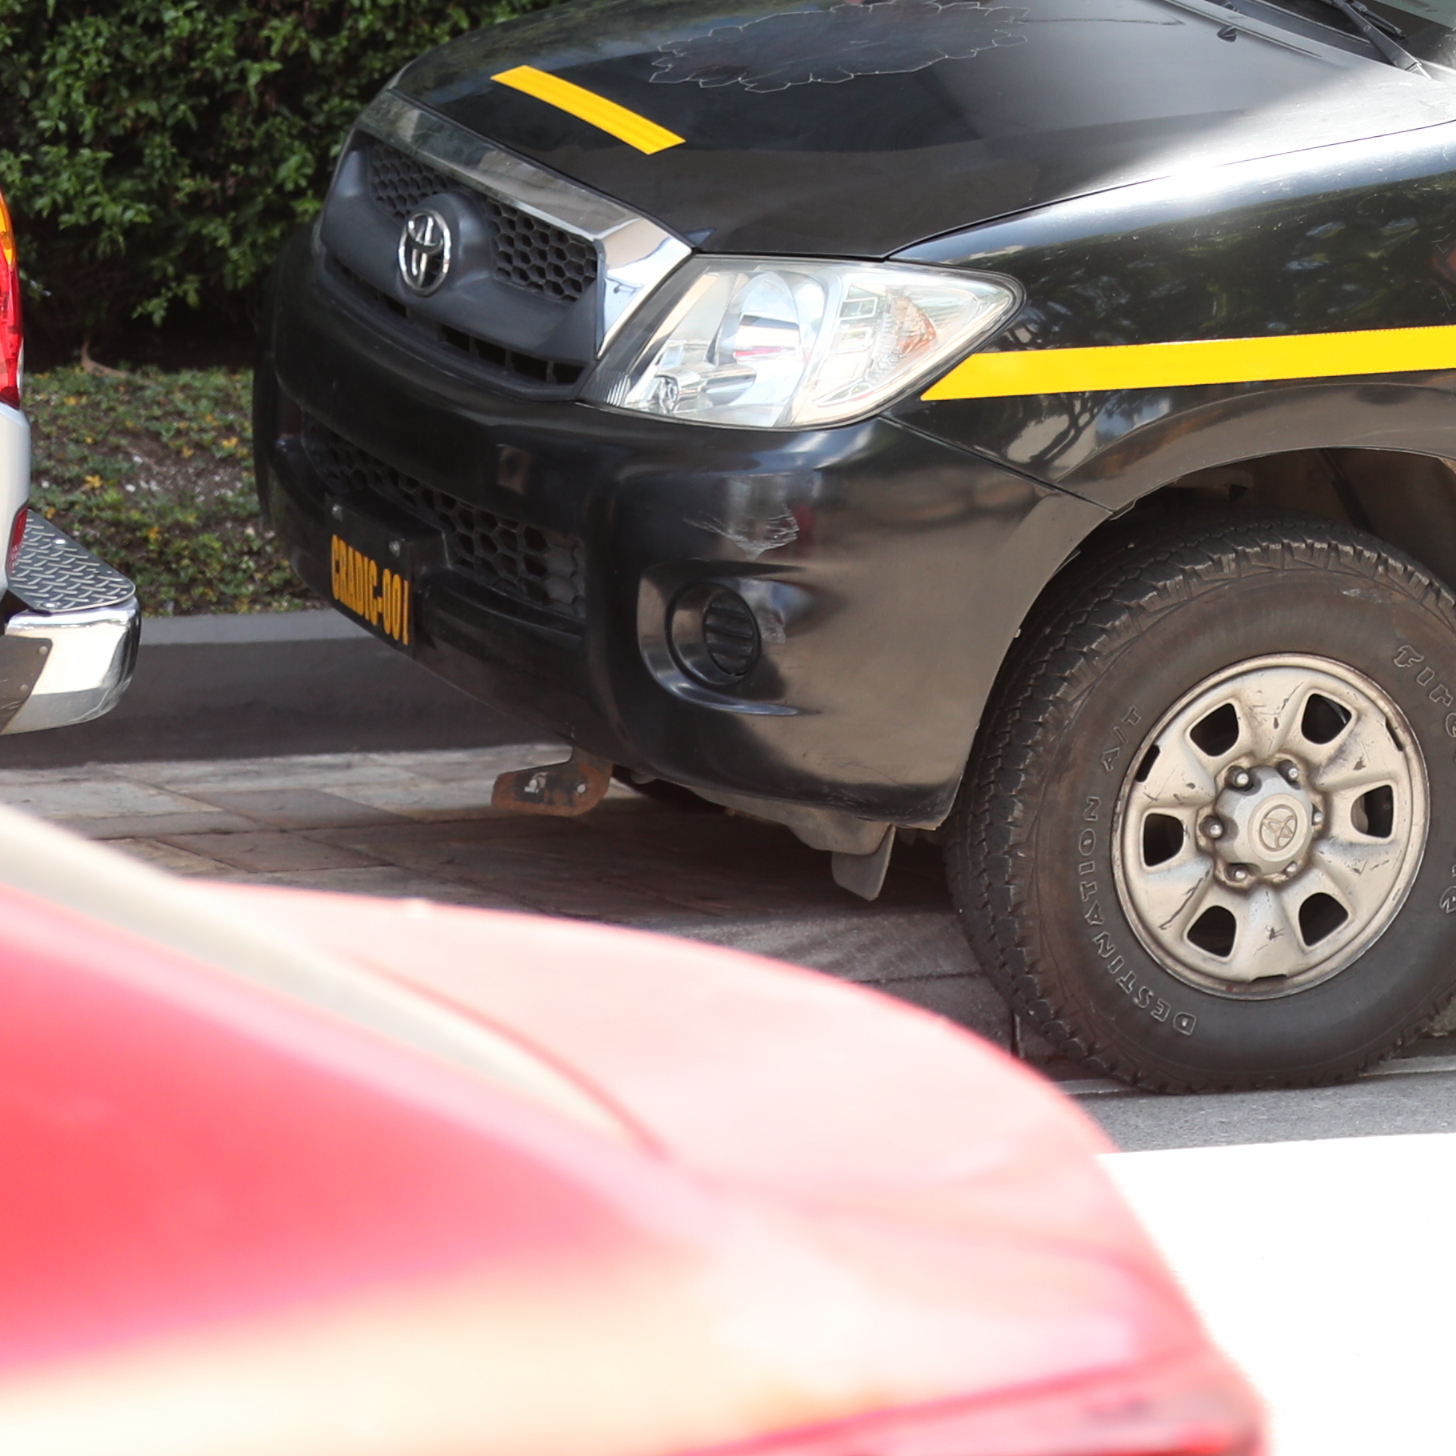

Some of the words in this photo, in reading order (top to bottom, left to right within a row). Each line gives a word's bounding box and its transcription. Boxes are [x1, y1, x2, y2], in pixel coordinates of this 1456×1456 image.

[330, 534, 410, 646] CRADIC-001
[1101, 704, 1142, 772] A/T
[1078, 796, 1198, 1037] DESTINATION
